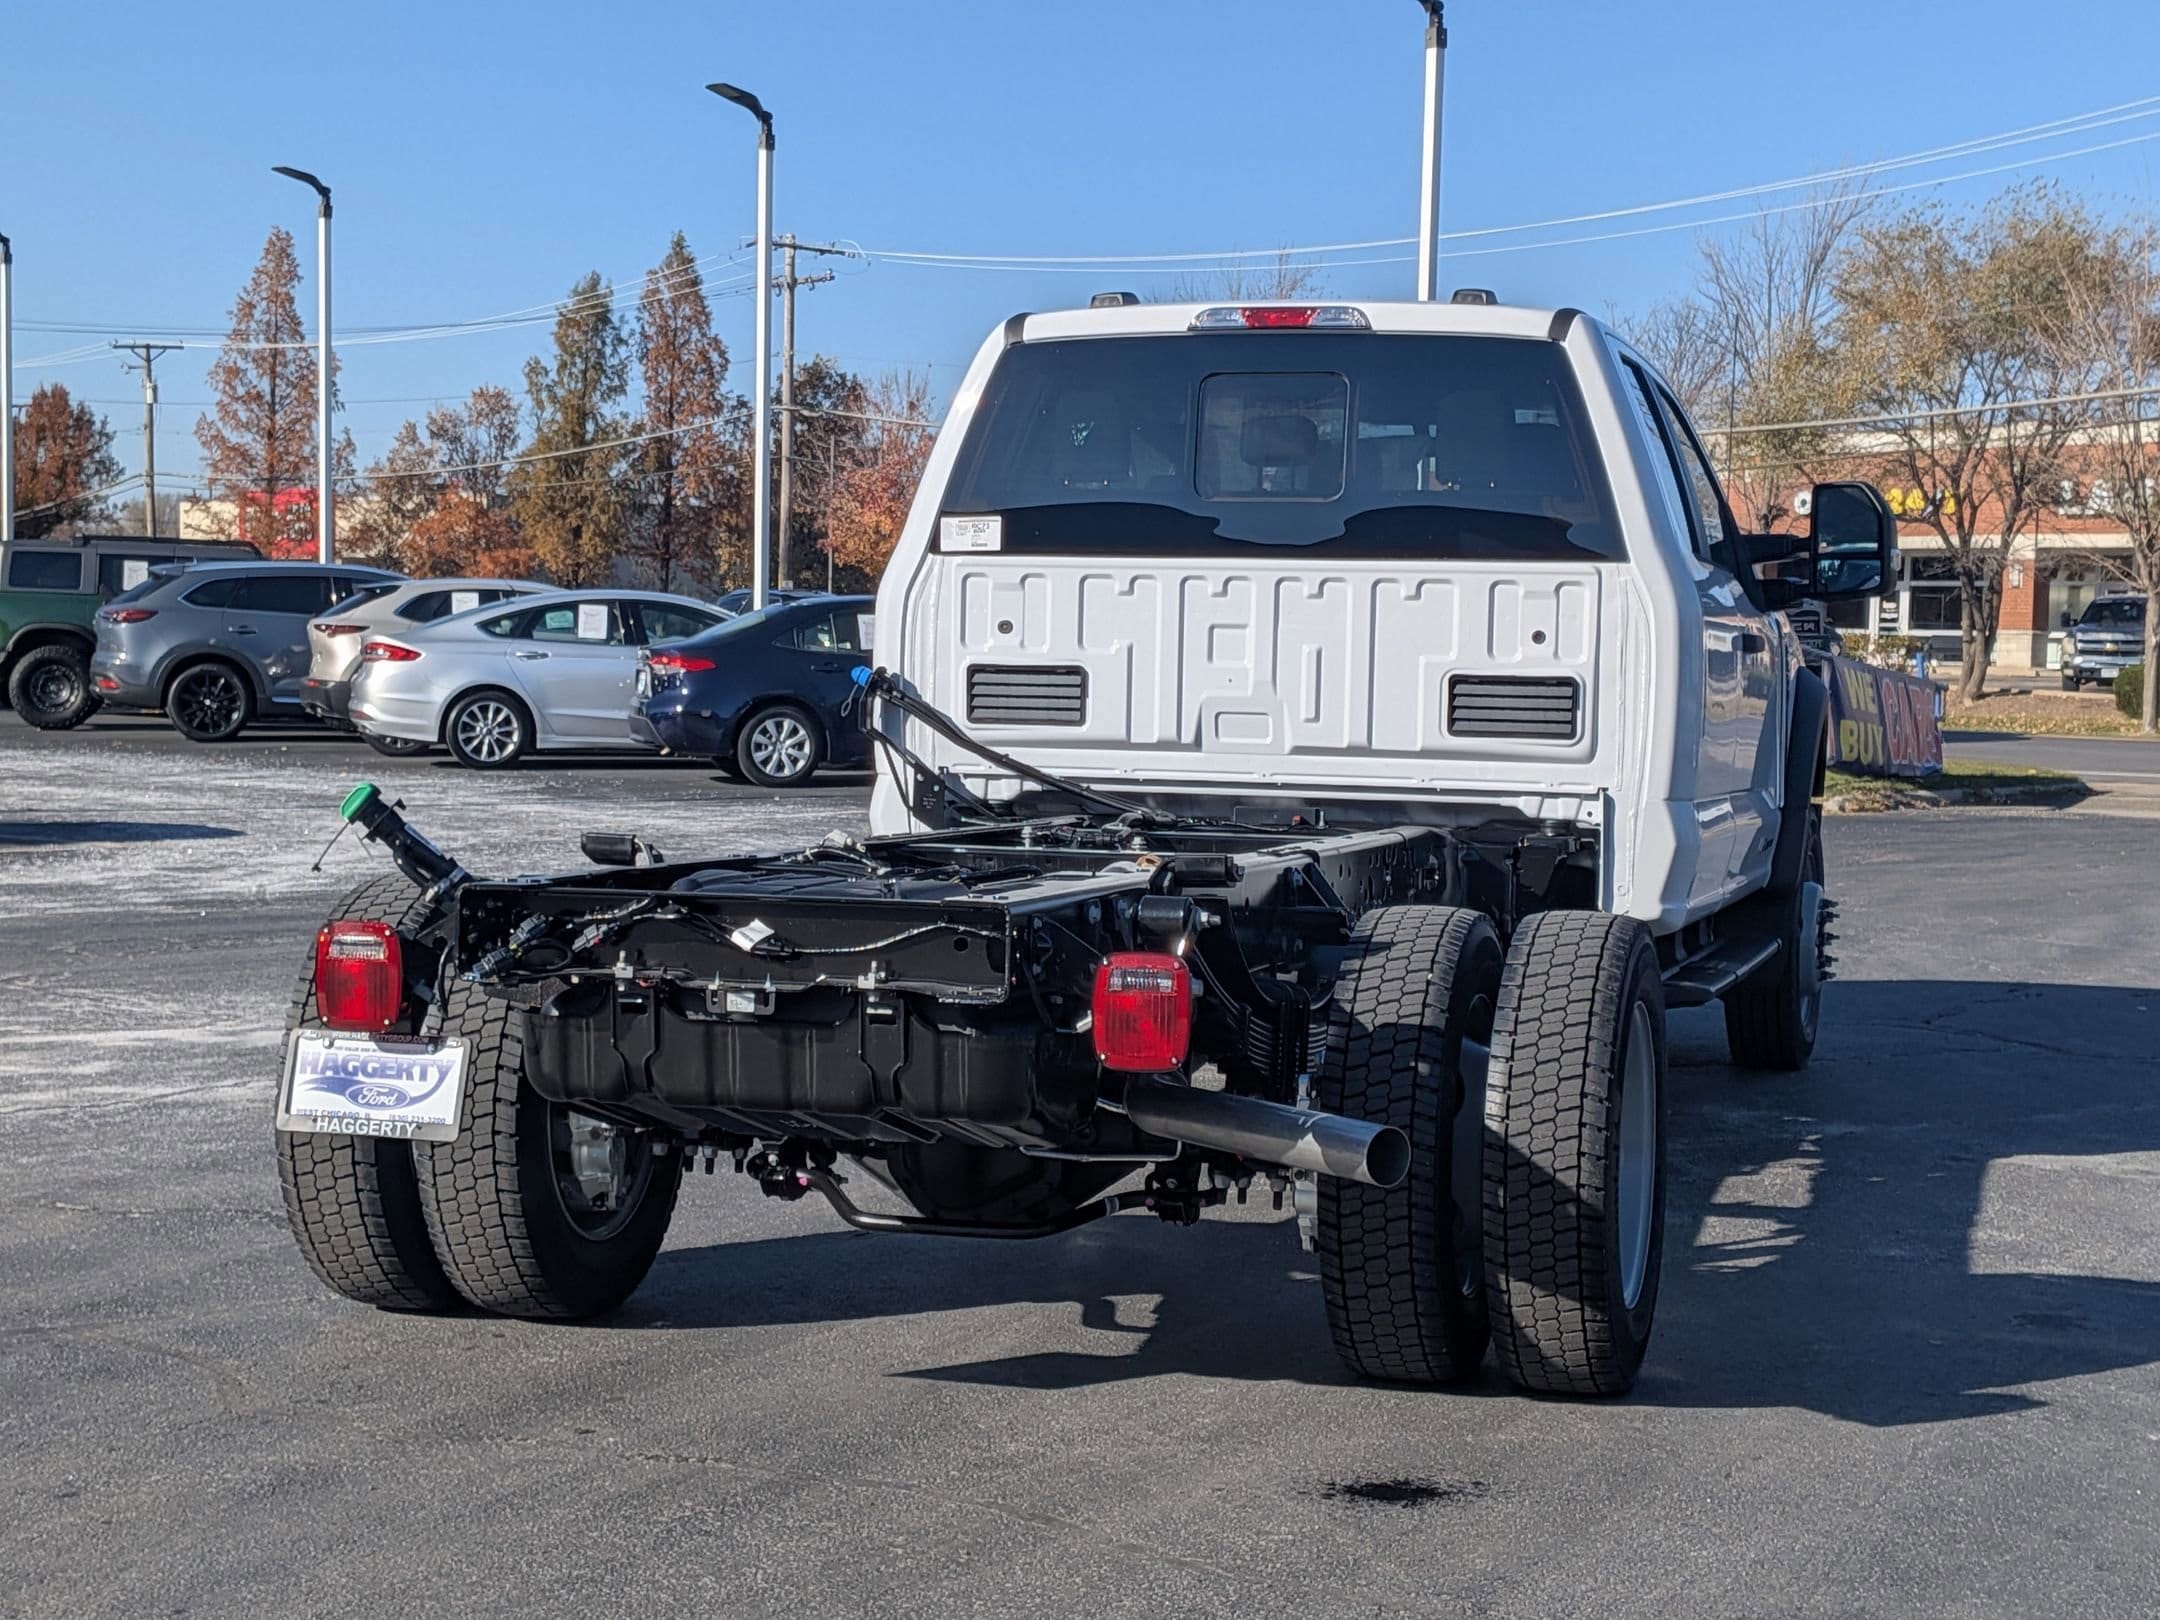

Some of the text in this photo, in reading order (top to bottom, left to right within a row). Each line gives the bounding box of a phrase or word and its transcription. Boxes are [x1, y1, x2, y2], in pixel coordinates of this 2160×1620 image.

[1843, 666, 1878, 714] WE
[1840, 720, 1884, 767] BUY
[299, 1051, 457, 1082] HAGGERTY
[357, 1086, 399, 1107] Ford
[315, 1117, 417, 1138] HAGGERTY
